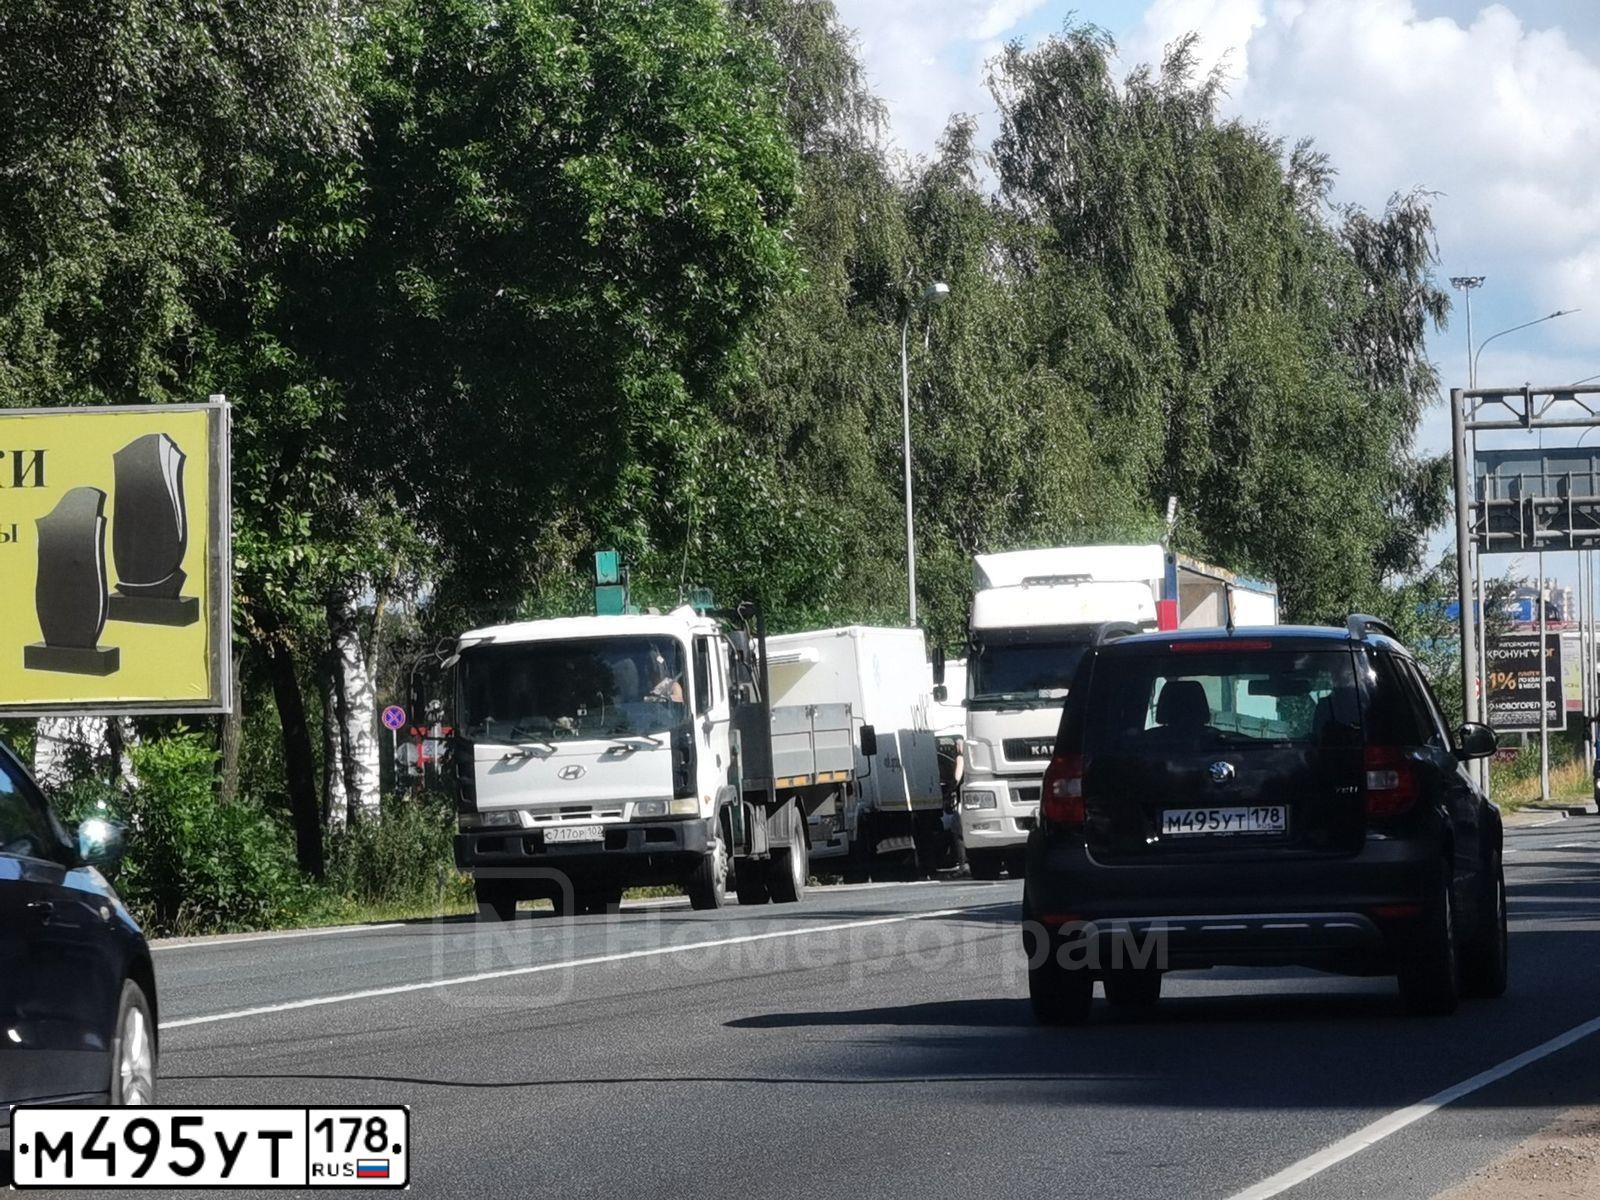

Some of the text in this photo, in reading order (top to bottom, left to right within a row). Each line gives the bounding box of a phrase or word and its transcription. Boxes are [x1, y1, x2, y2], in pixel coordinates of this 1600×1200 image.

[1489, 671, 1517, 690] 1%
[1168, 808, 1280, 832] М495УТ 178
